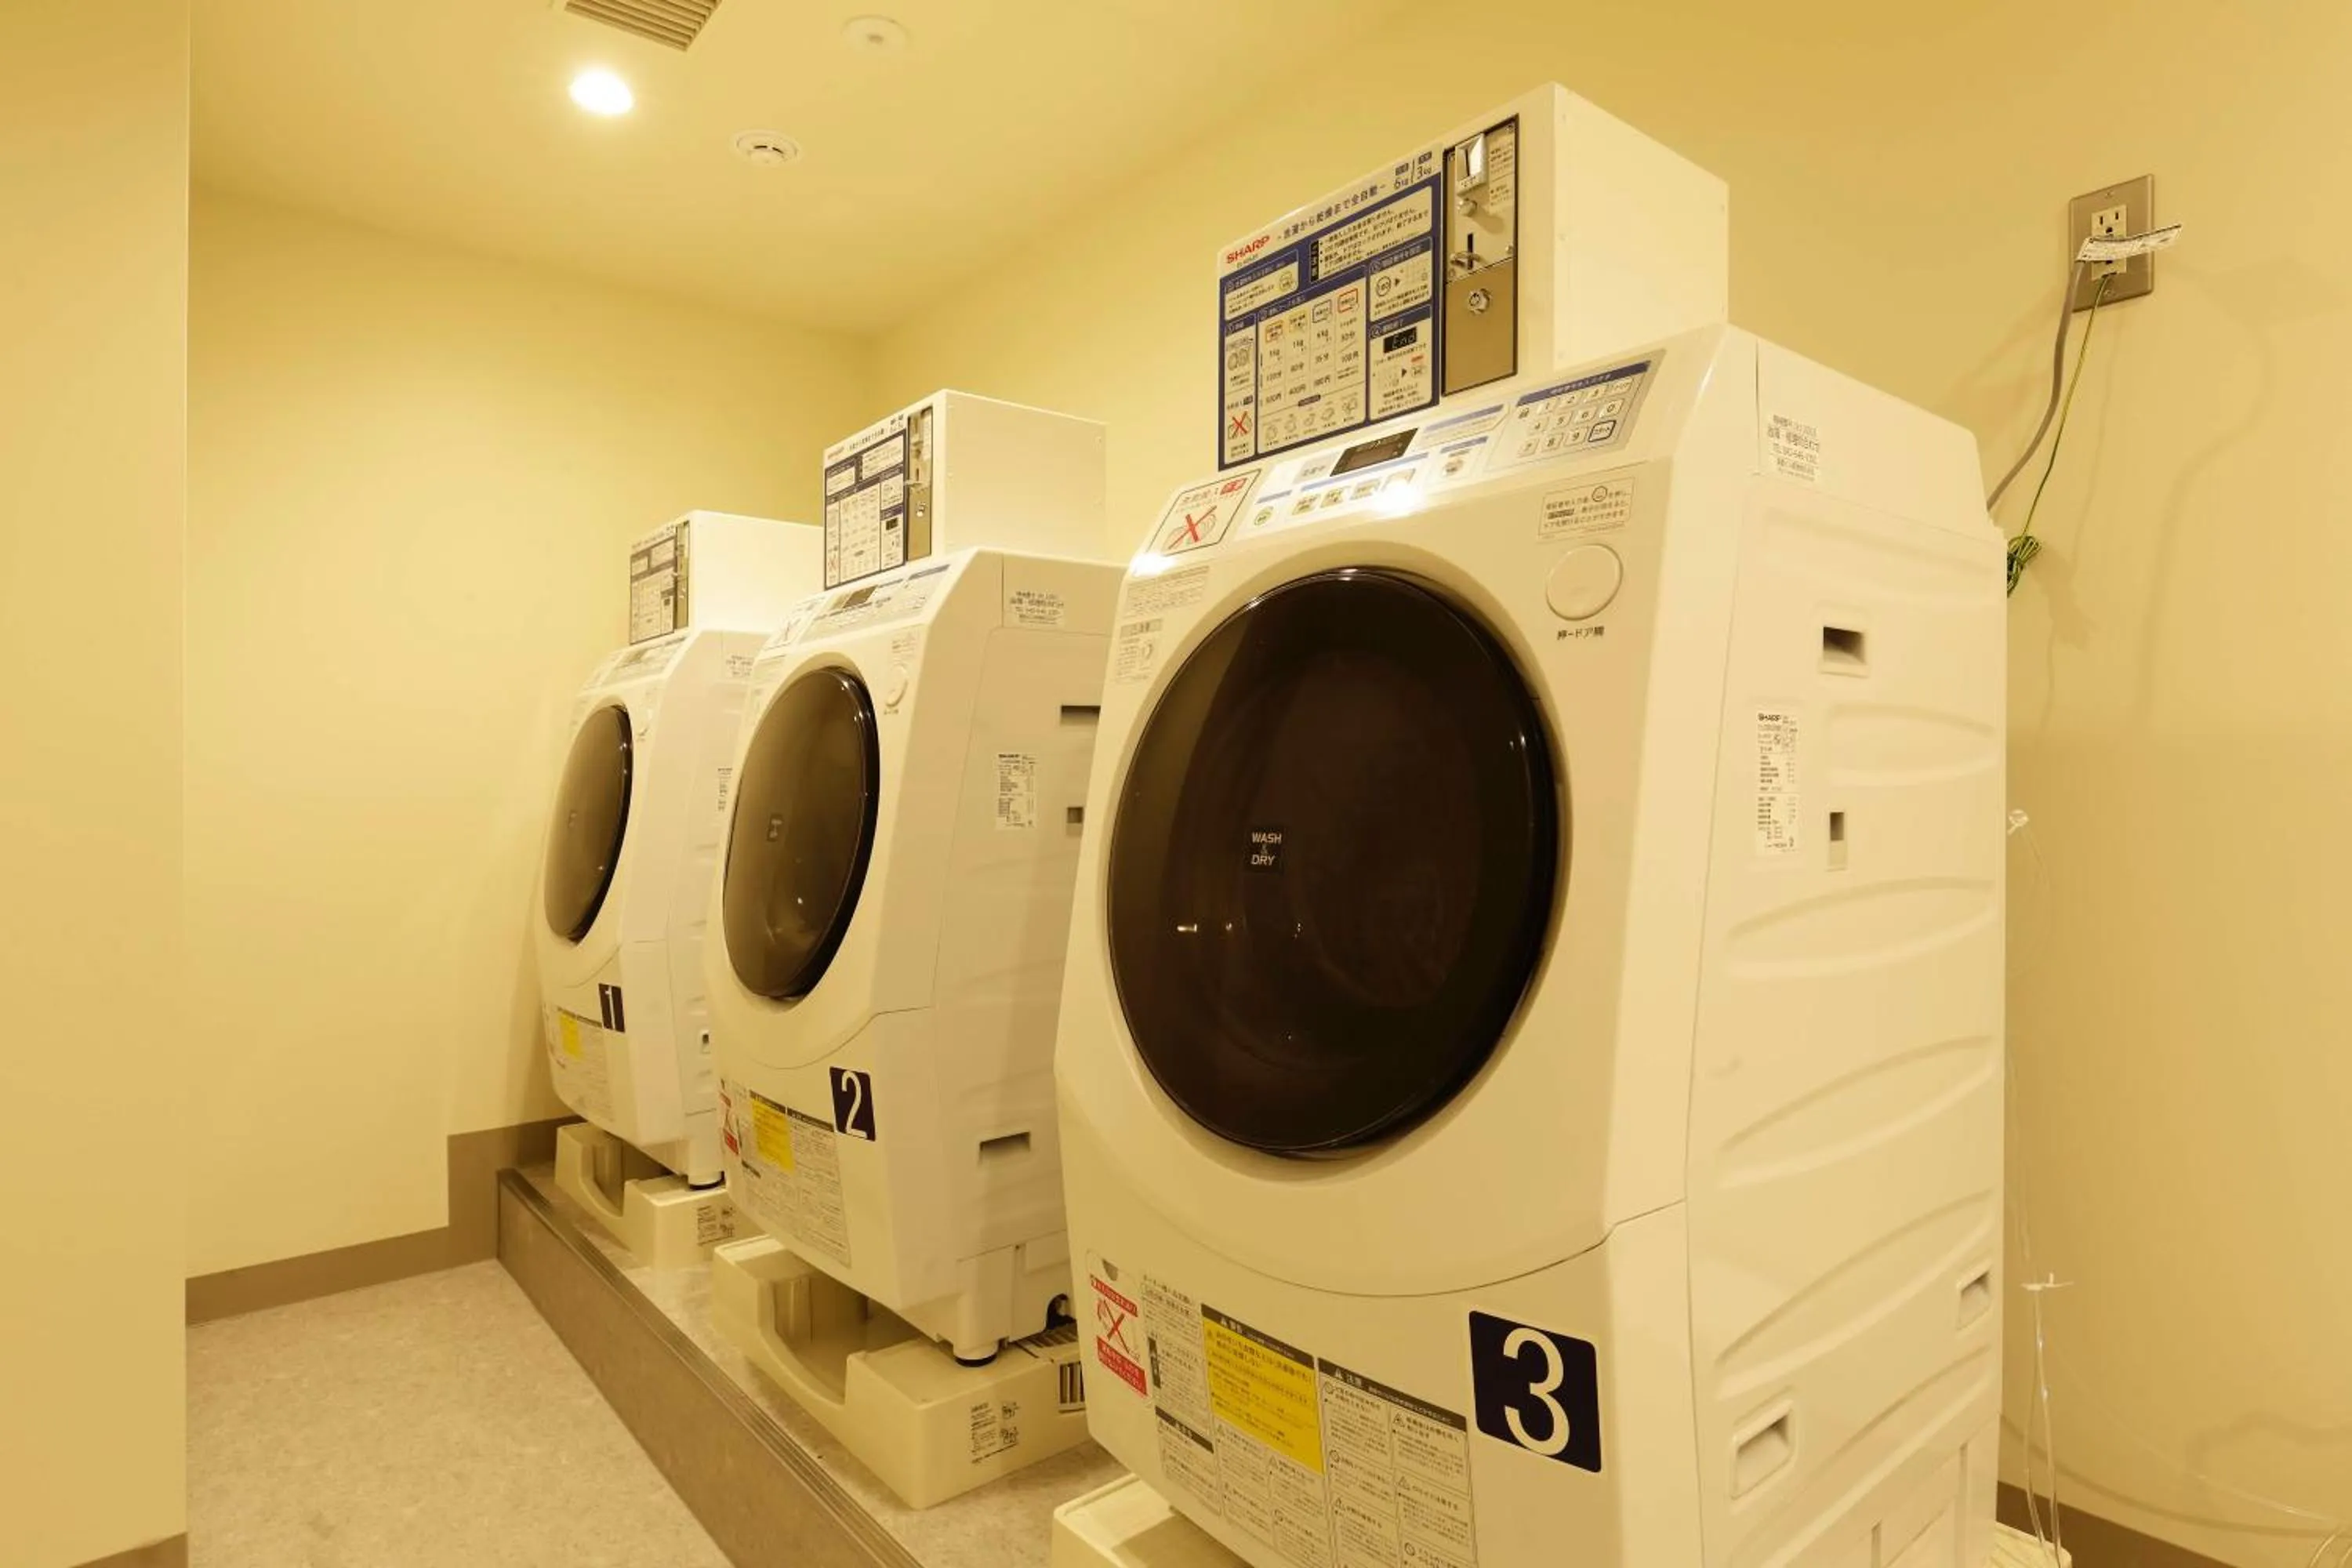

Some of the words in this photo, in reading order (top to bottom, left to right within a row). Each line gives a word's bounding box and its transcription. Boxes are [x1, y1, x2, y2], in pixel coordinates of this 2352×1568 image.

[1226, 234, 1270, 264] SHARP
[1252, 832, 1283, 844] WASH
[1251, 854, 1276, 866] DRY
[604, 985, 616, 1030] 1
[841, 1069, 868, 1138] 2
[1503, 1327, 1570, 1456] 3
